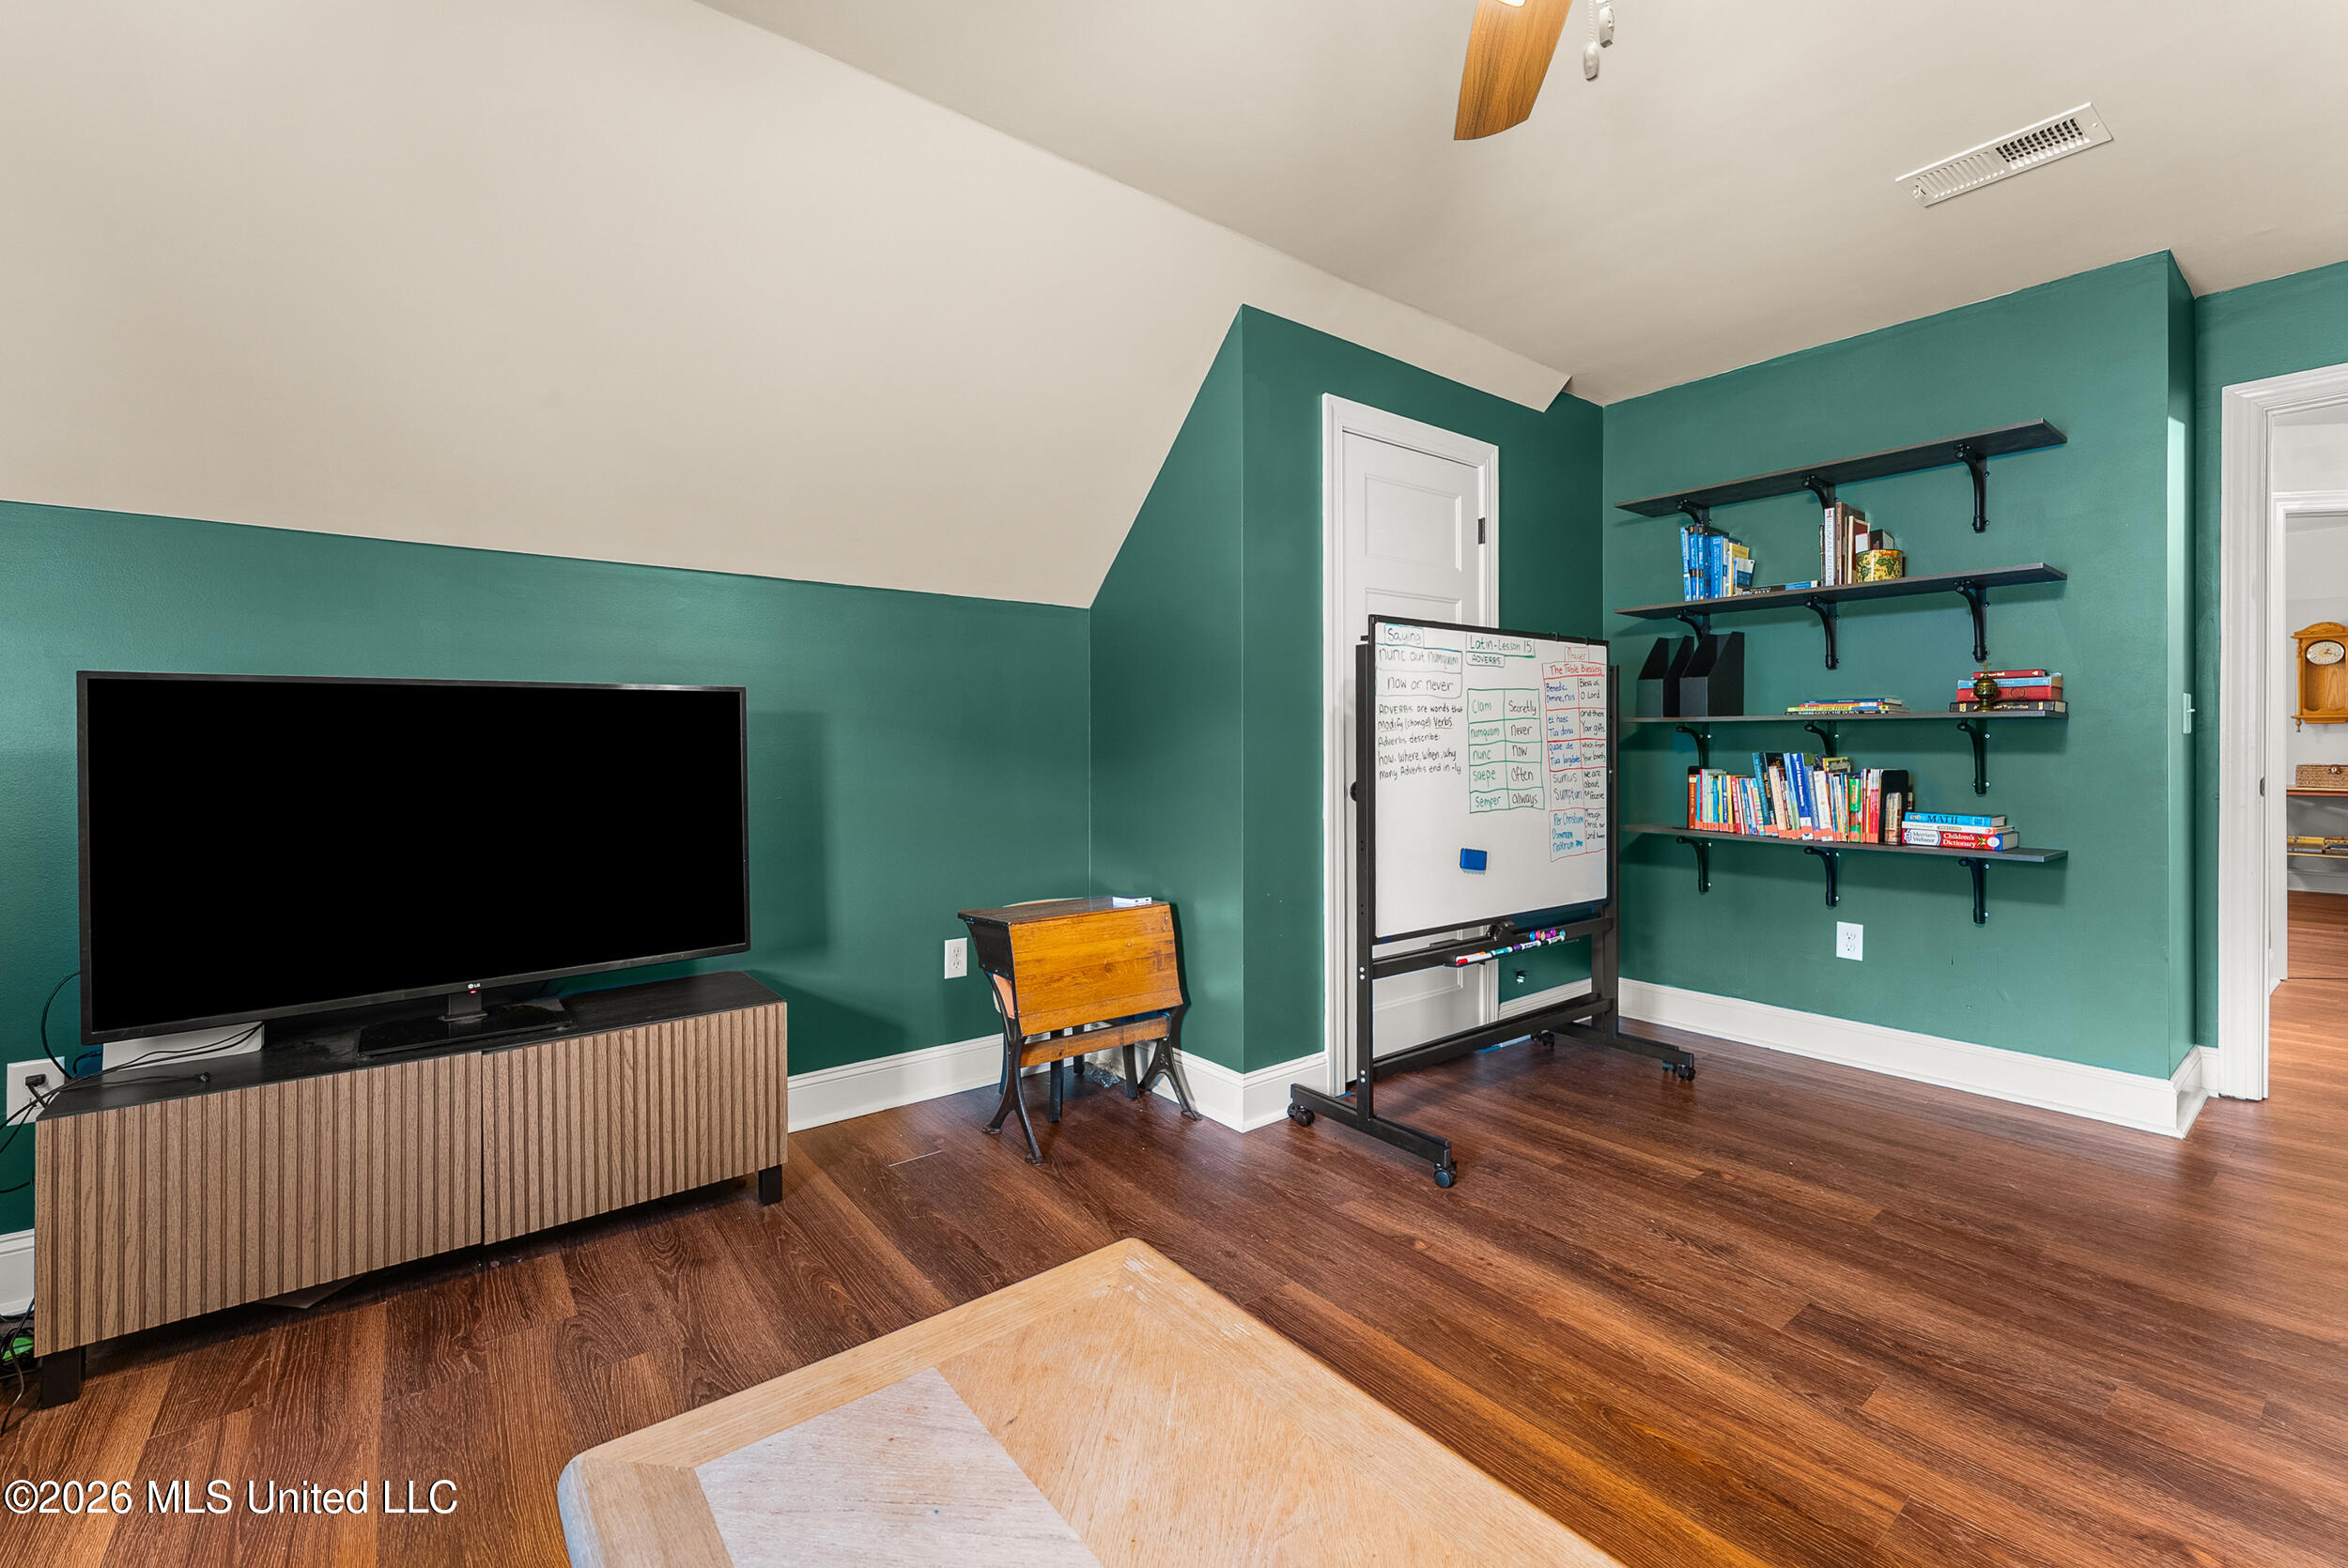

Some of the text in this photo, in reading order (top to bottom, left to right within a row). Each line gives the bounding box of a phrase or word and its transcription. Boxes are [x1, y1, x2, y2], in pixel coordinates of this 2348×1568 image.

[1387, 627, 1421, 645] Saying
[1523, 639, 1533, 653] 15
[1472, 654, 1501, 665] ADVERBS
[1550, 663, 1602, 676] The Table Blessing
[1411, 680, 1423, 690] or
[1581, 689, 1600, 700] O Lord
[1416, 705, 1428, 714] are
[1430, 702, 1449, 714] words
[1561, 725, 1574, 735] dona
[1409, 732, 1439, 744] describe
[1444, 747, 1457, 762] why
[1473, 749, 1491, 761] nunc
[1429, 761, 1442, 774] end
[1443, 764, 1450, 773] in
[1473, 769, 1496, 789] saepe
[1927, 814, 1958, 824] MATH
[1943, 833, 1975, 841] Children's
[1942, 838, 1976, 849] Dictionary
